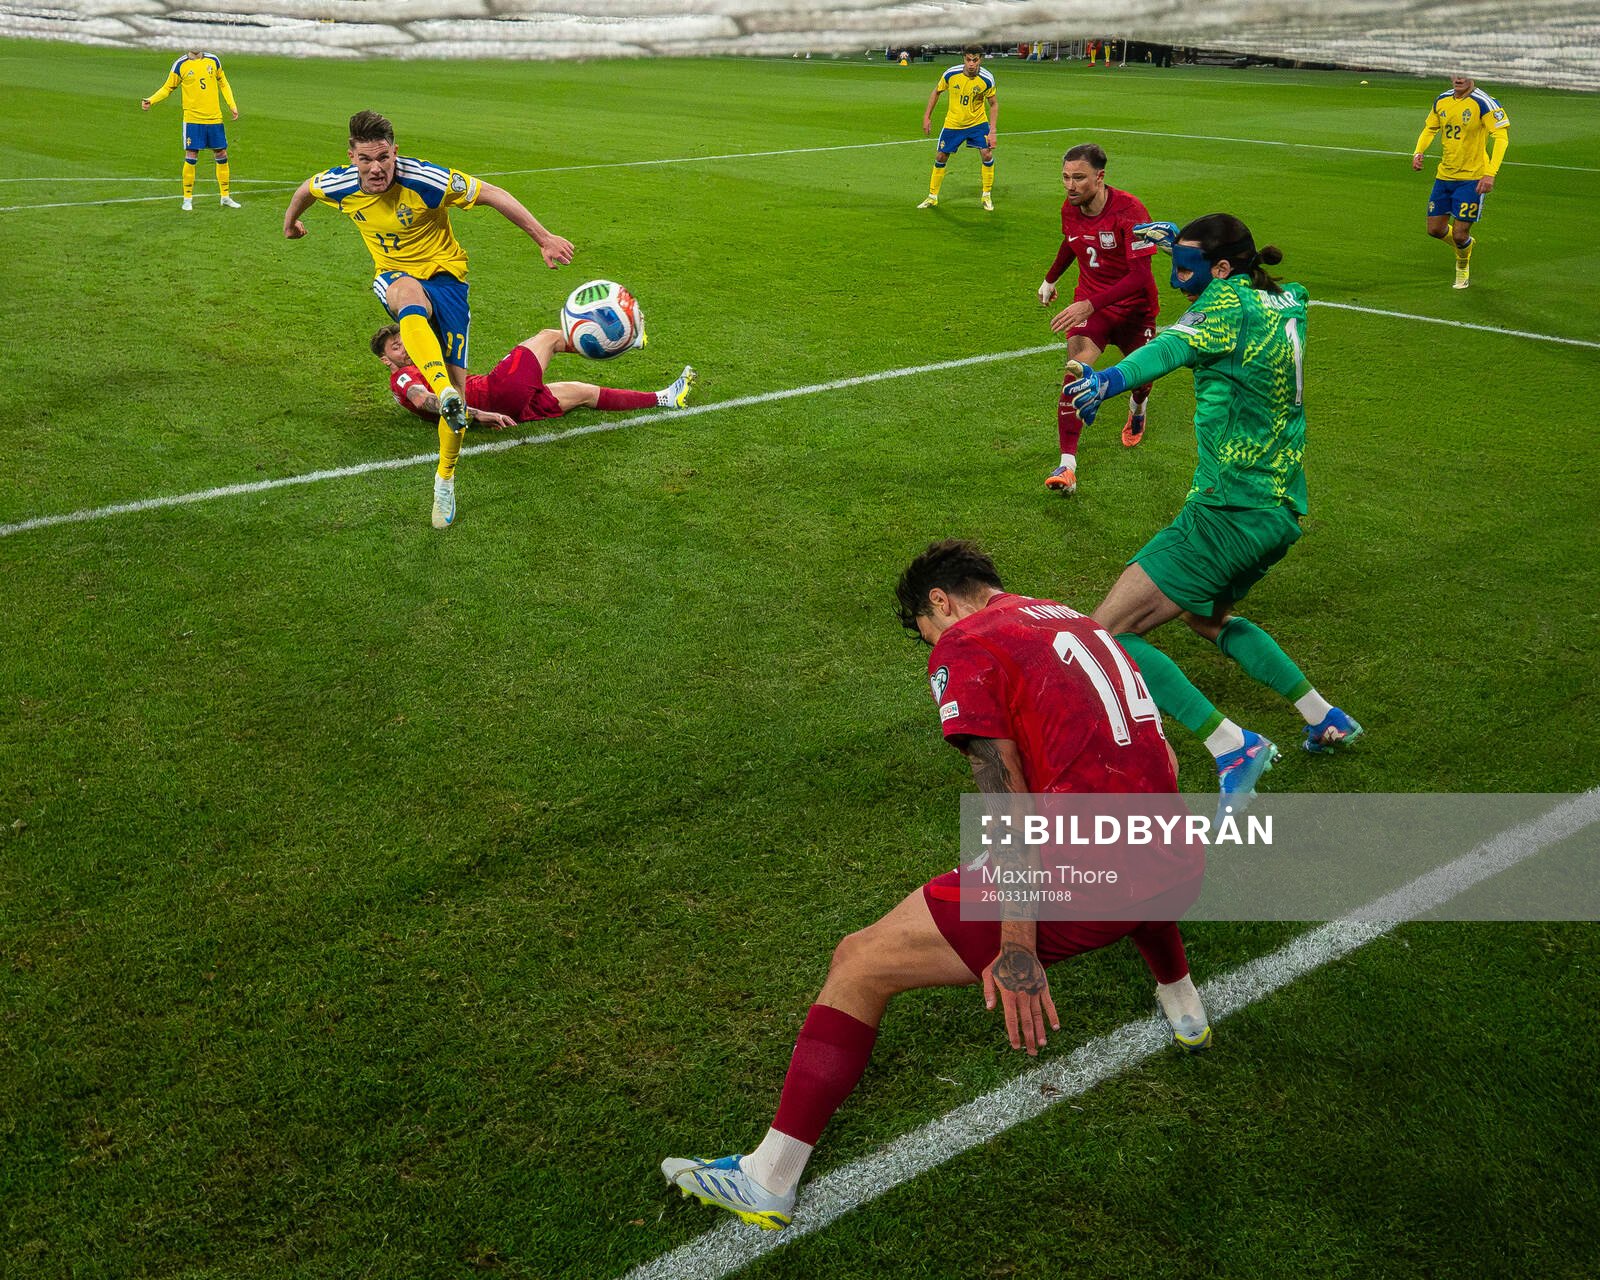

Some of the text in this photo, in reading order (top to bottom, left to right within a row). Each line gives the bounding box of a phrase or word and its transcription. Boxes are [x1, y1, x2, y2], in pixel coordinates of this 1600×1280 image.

[199, 77, 207, 90] 5
[960, 95, 970, 106] 18
[1444, 124, 1461, 140] 22
[1459, 202, 1478, 217] 22
[1086, 246, 1100, 268] 2
[445, 331, 465, 360] 17
[1284, 317, 1304, 406] 1
[1052, 629, 1166, 747] 14
